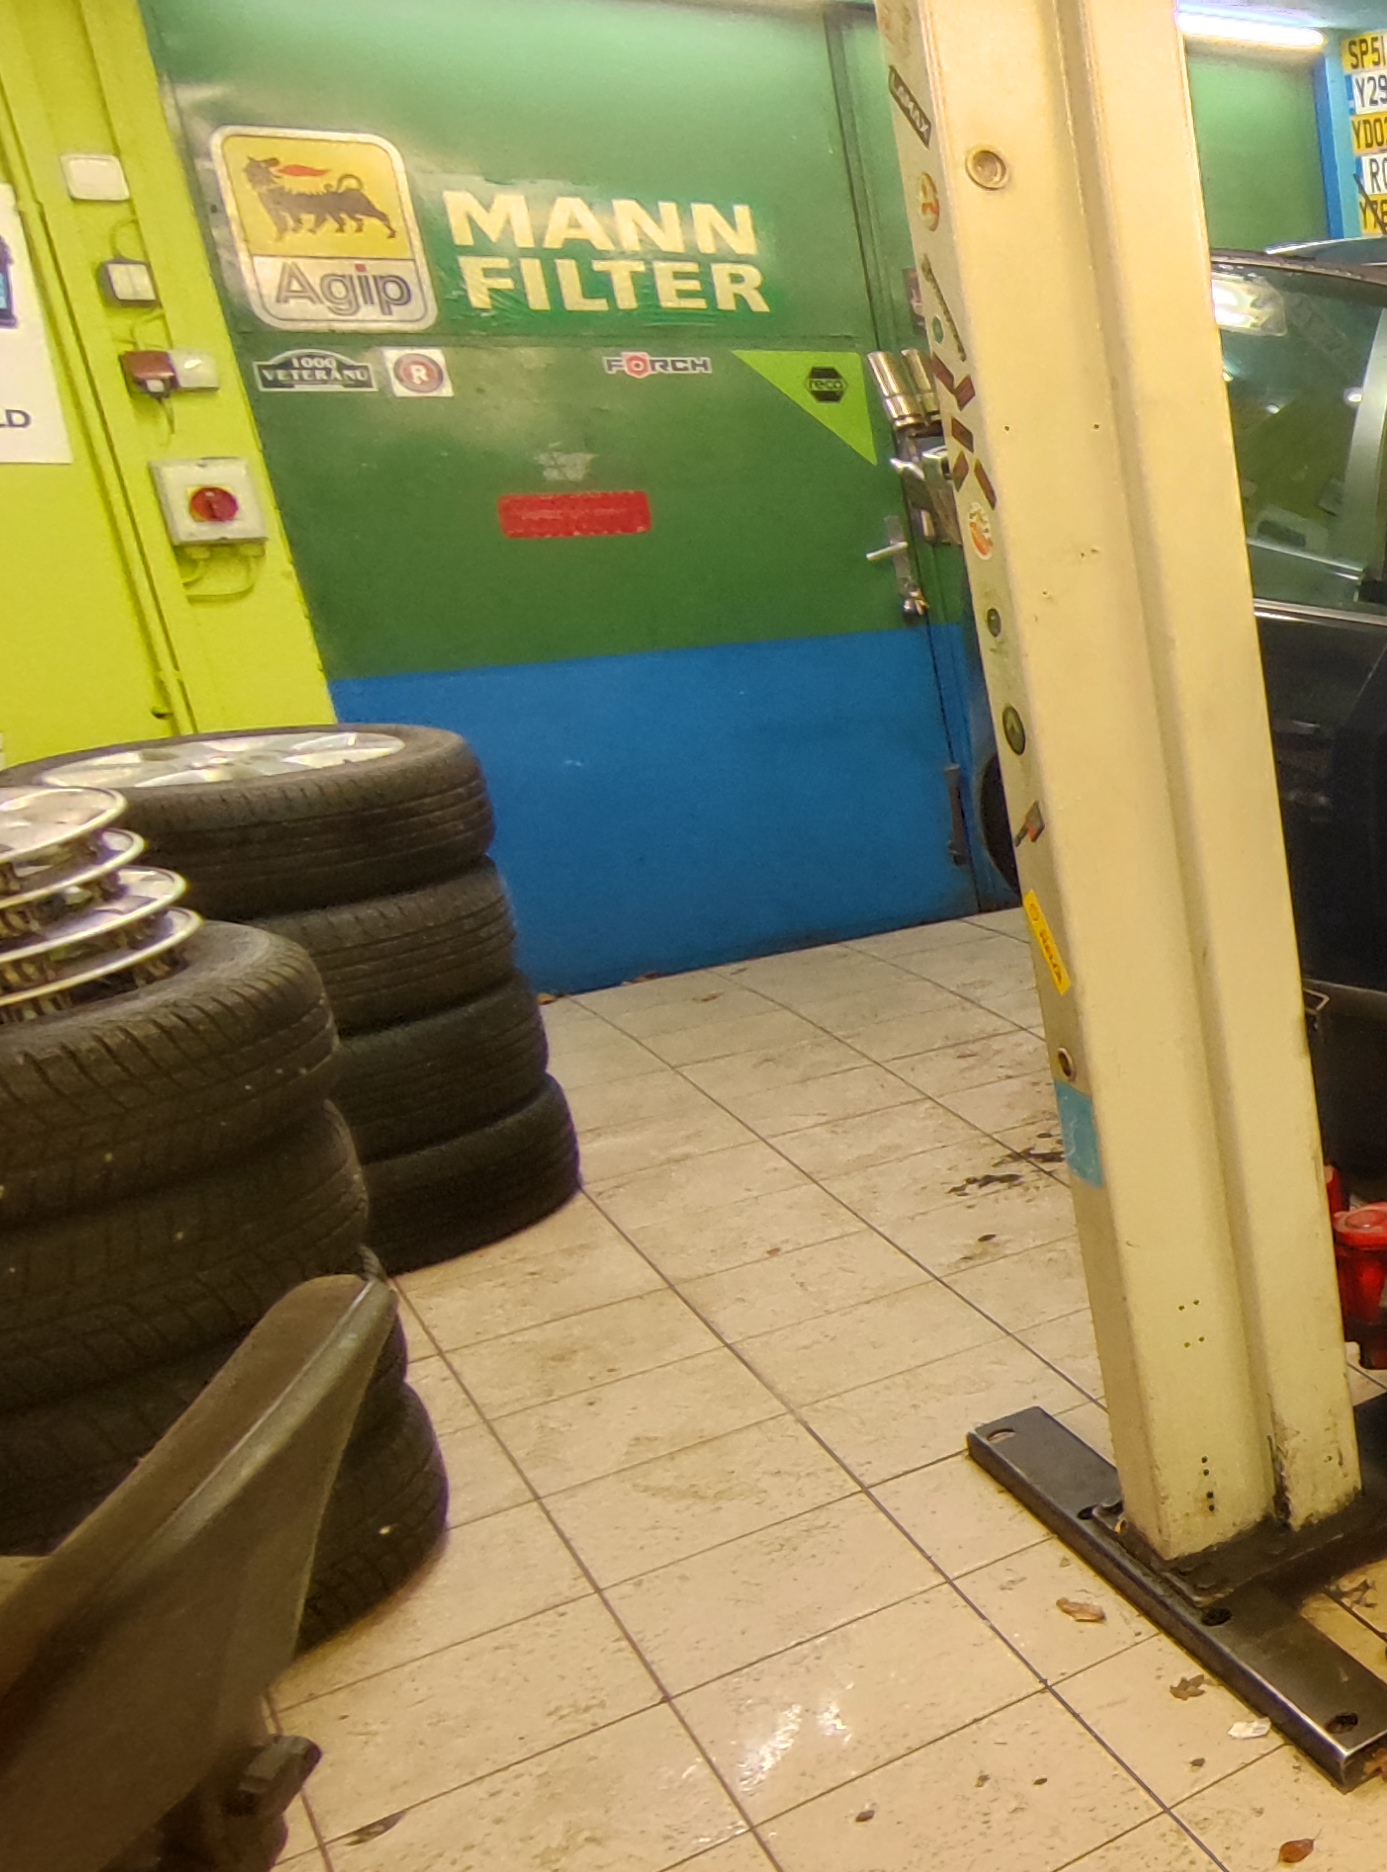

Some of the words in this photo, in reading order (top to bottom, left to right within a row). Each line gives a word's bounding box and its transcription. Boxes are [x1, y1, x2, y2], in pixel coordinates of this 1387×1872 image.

[442, 190, 759, 256] MANN
[275, 262, 412, 316] Agip
[457, 255, 771, 313] FILTER
[291, 356, 338, 369] 1000
[410, 364, 430, 385] R
